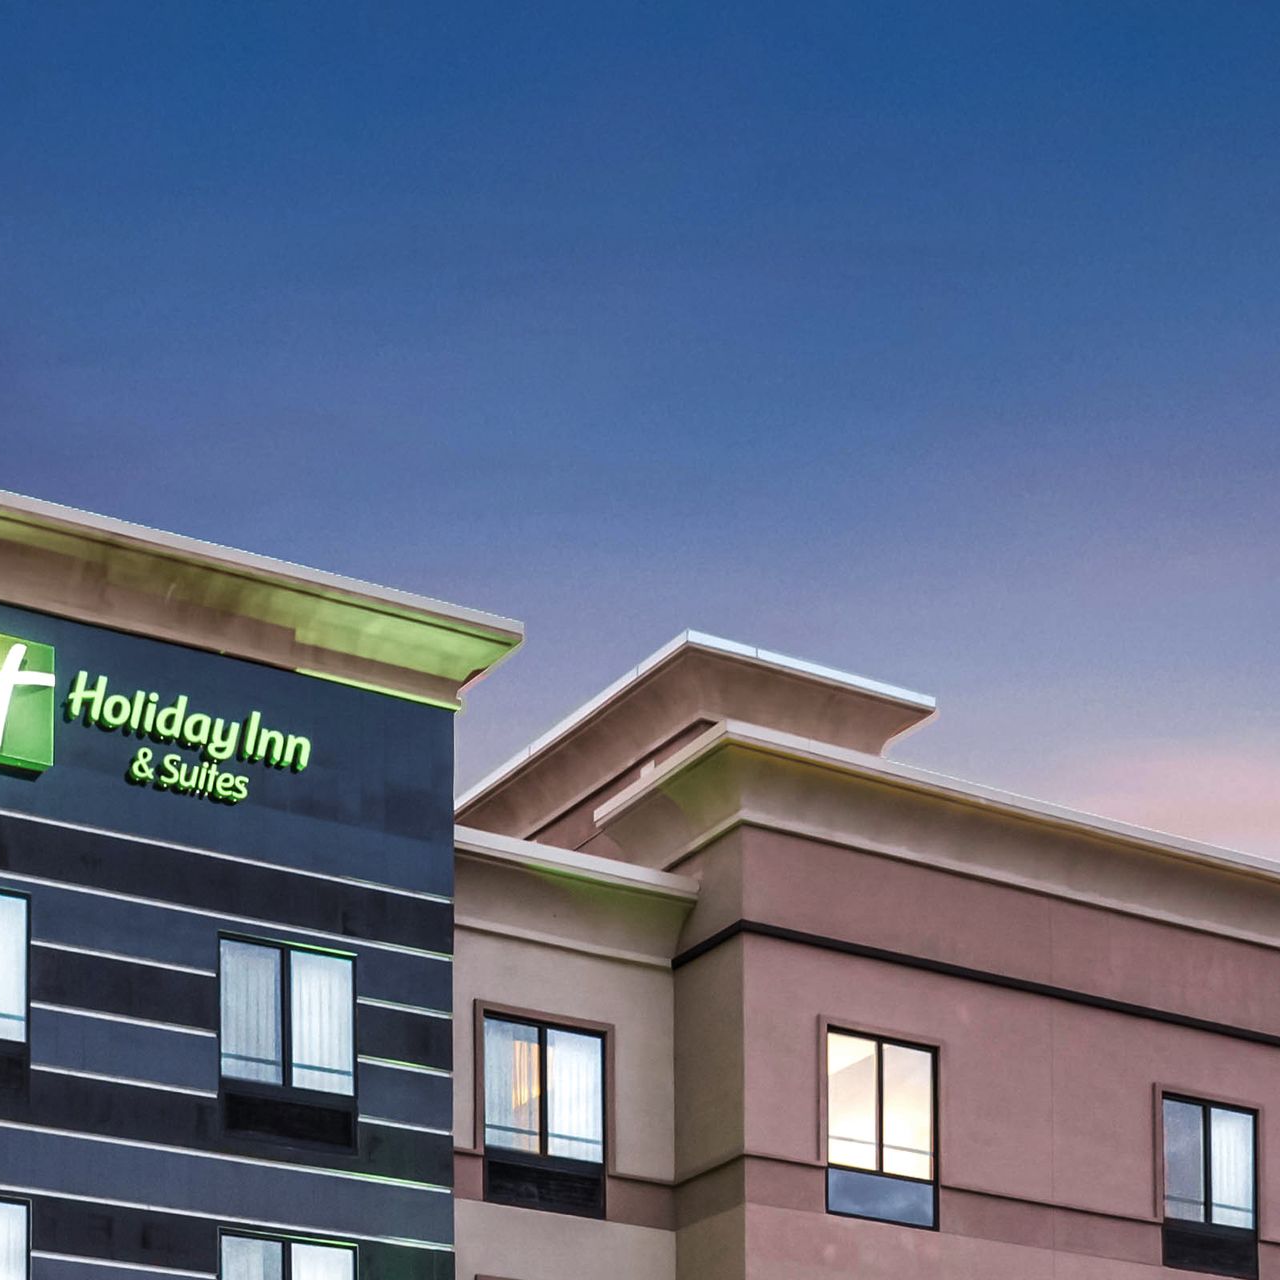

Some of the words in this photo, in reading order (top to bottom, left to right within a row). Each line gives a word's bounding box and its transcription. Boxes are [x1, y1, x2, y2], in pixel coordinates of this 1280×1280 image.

[68, 670, 240, 760] Holiday
[244, 711, 311, 771] Inn
[131, 747, 154, 782] &
[160, 753, 249, 801] Suites
